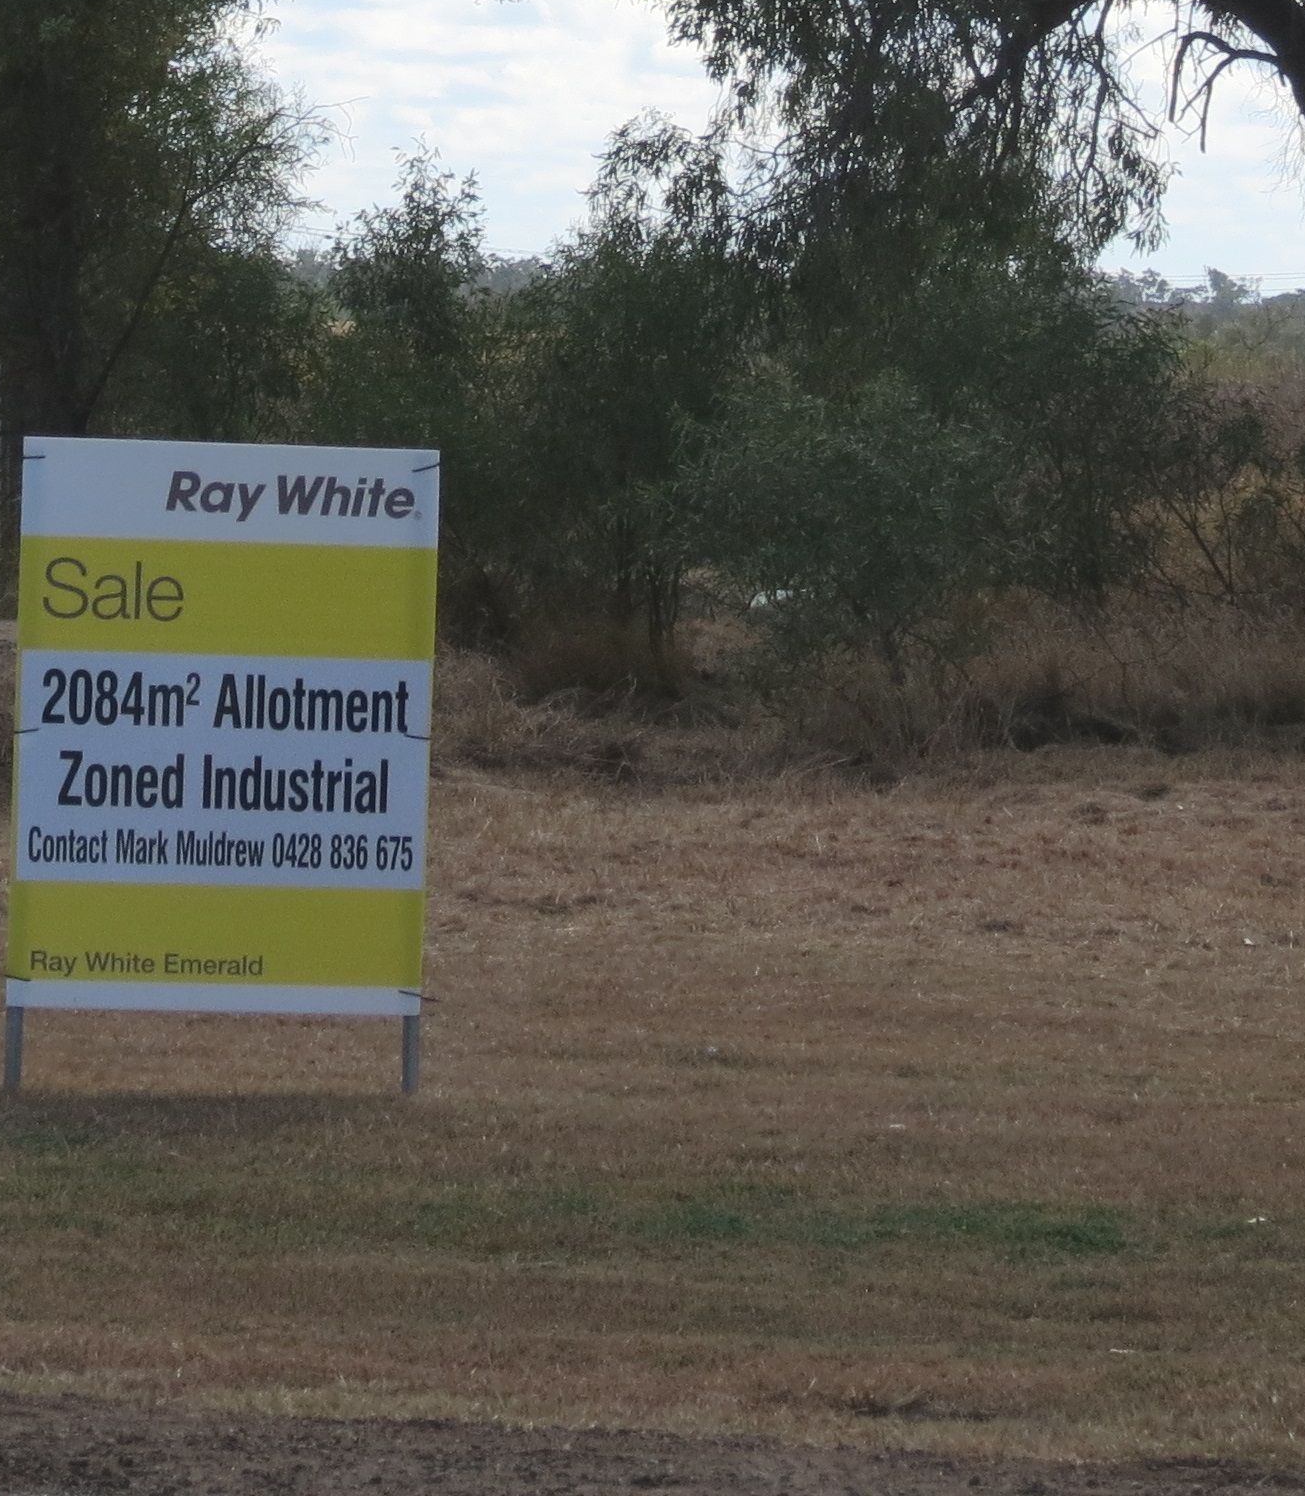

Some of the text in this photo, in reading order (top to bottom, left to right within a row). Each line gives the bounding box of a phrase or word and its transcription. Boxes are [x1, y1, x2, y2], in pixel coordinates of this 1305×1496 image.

[166, 470, 415, 522] Ray White
[42, 557, 184, 621] Sale
[213, 673, 409, 733] Allotment
[57, 750, 389, 814] Zoned Industrial
[28, 826, 413, 871] Contact Mark Muldrew 0428 836 675
[29, 950, 264, 977] Ray White Emerald
